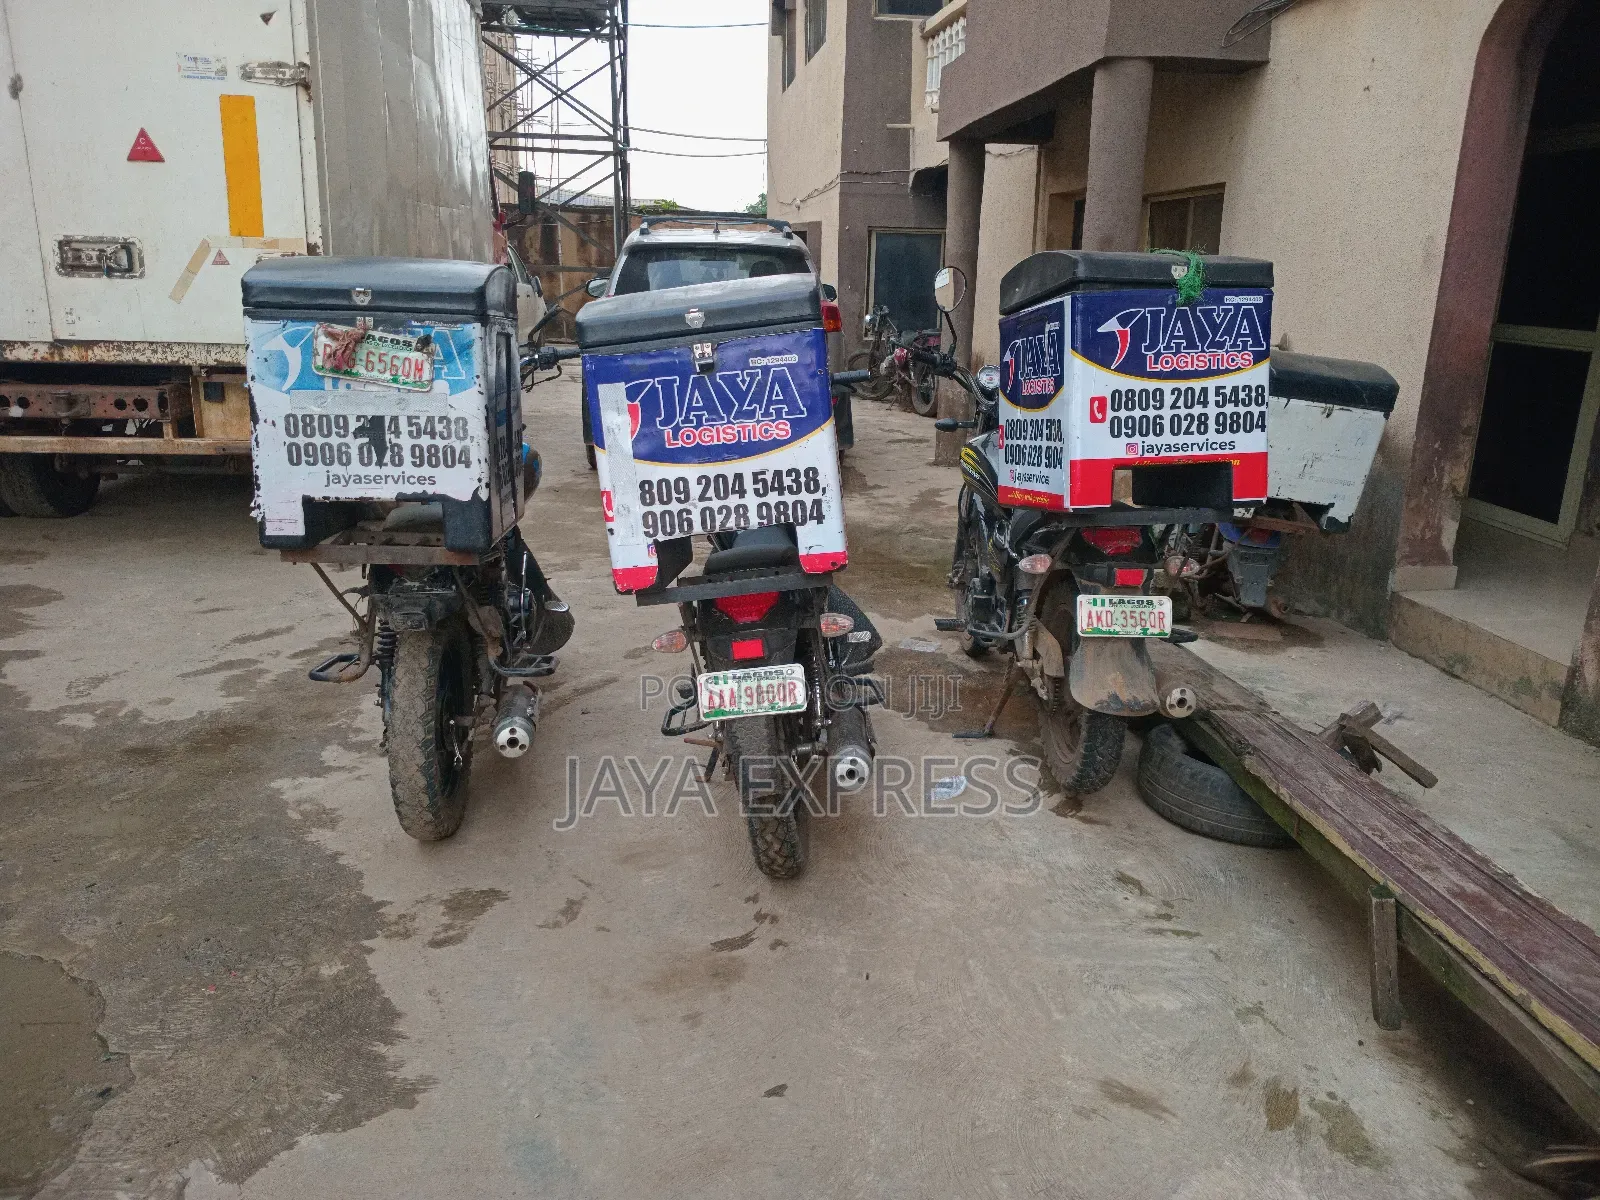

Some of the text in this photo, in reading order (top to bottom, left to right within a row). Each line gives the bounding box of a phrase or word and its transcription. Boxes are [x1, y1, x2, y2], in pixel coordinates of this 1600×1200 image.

[1141, 305, 1266, 354] JAYA
[1146, 351, 1254, 371] LOGISTICS
[655, 367, 807, 429] JAYA
[1110, 388, 1165, 413] 0809
[1170, 387, 1209, 410] 204
[284, 413, 350, 438] 0809
[355, 415, 402, 439] 24
[665, 419, 792, 449] LOGISTICS
[1109, 411, 1267, 438] 0906 028 9804
[287, 442, 352, 467] 0906
[358, 443, 404, 467] 08
[410, 443, 472, 468] 9804
[1139, 437, 1236, 457] jayaservices
[324, 470, 437, 487] jayaservices
[639, 467, 827, 507] 809 204 5438,
[642, 498, 825, 538] 906 028 9804
